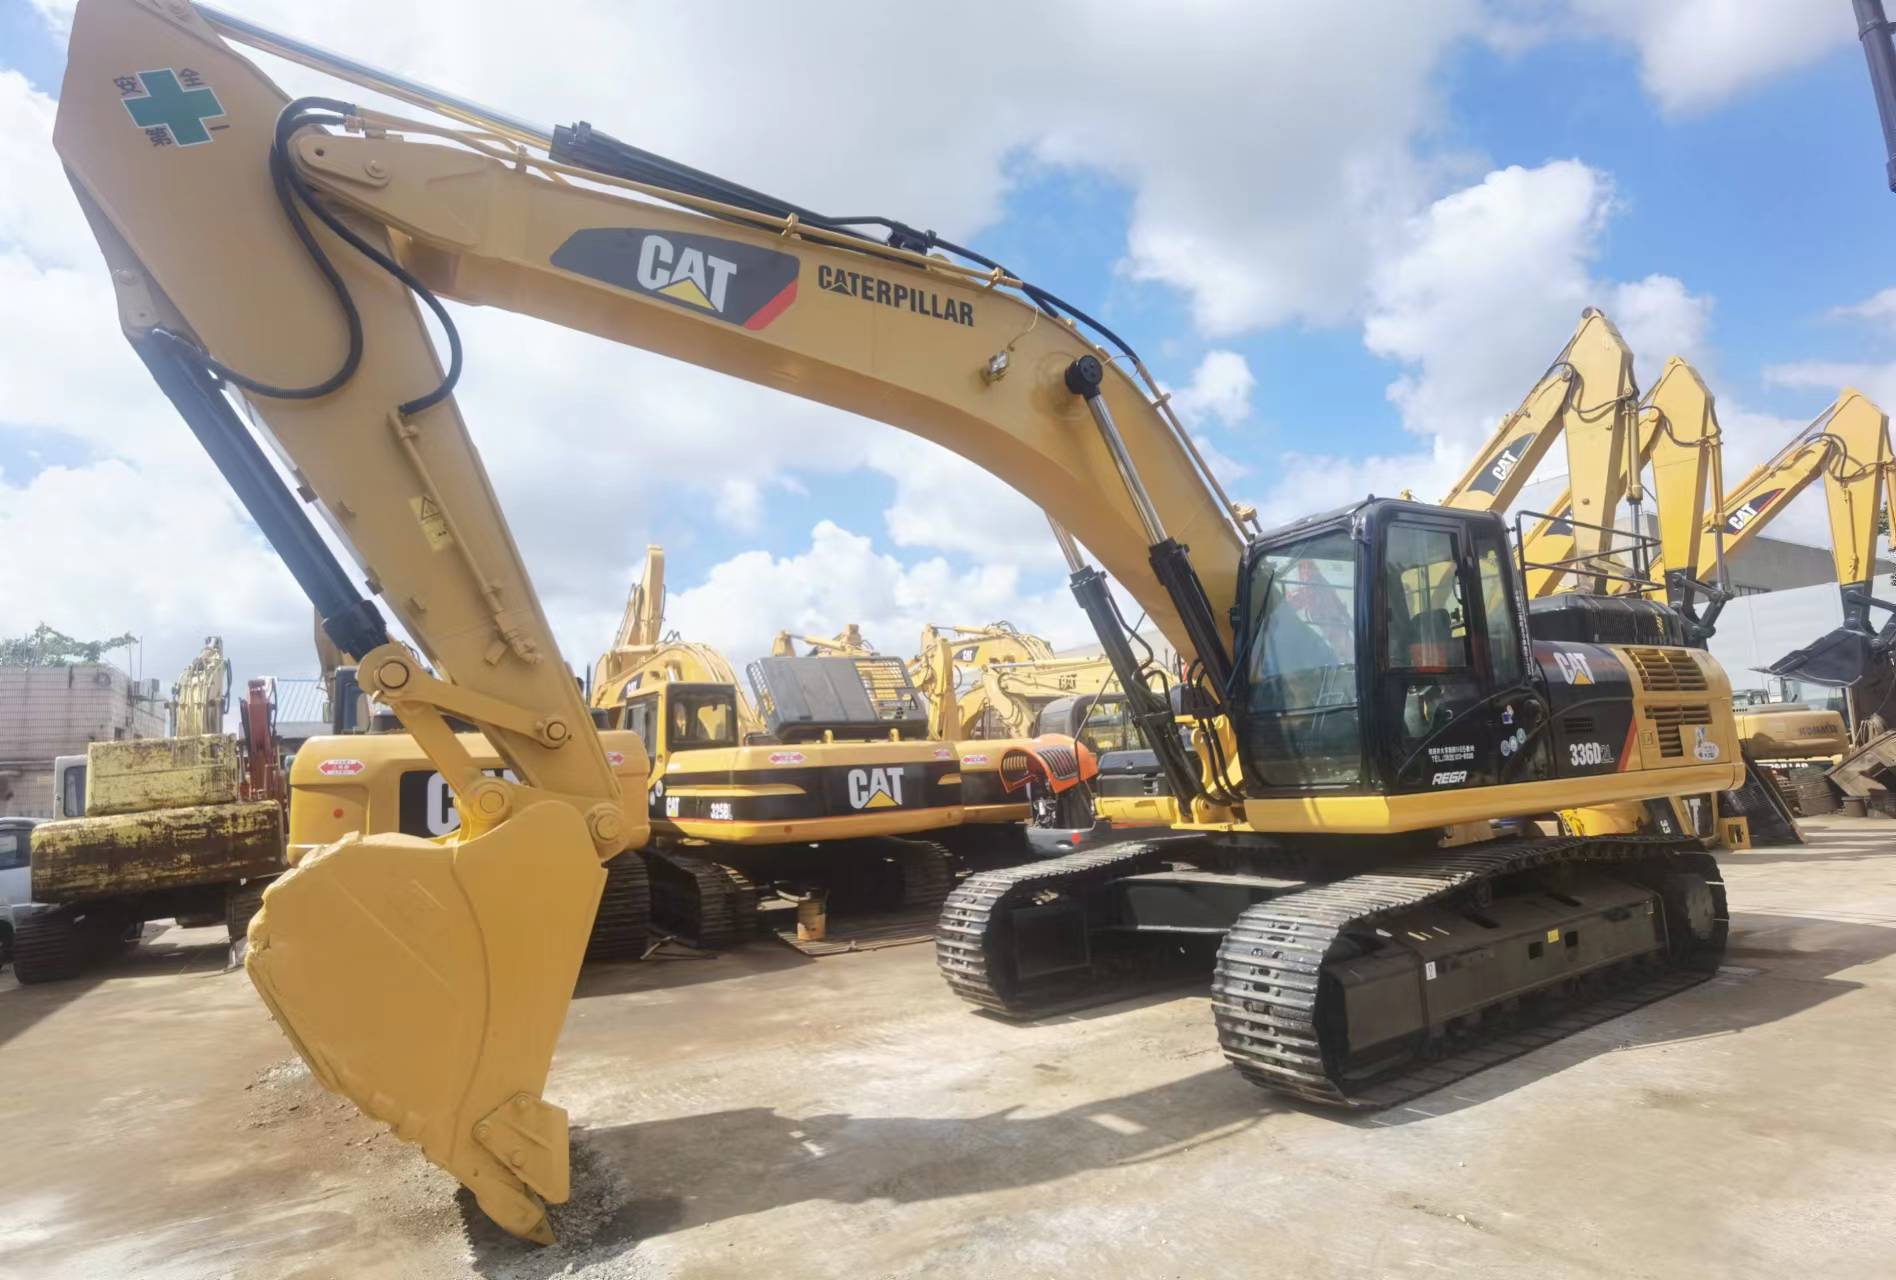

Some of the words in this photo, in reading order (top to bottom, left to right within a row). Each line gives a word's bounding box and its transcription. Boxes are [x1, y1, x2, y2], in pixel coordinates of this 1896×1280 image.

[636, 234, 738, 313] CAT
[818, 264, 974, 327] CATERPILLAR
[1492, 449, 1518, 481] CAT
[1728, 502, 1758, 530] CAT
[1552, 652, 1596, 685] CAT
[848, 767, 904, 810] CAT
[666, 796, 680, 818] CAT
